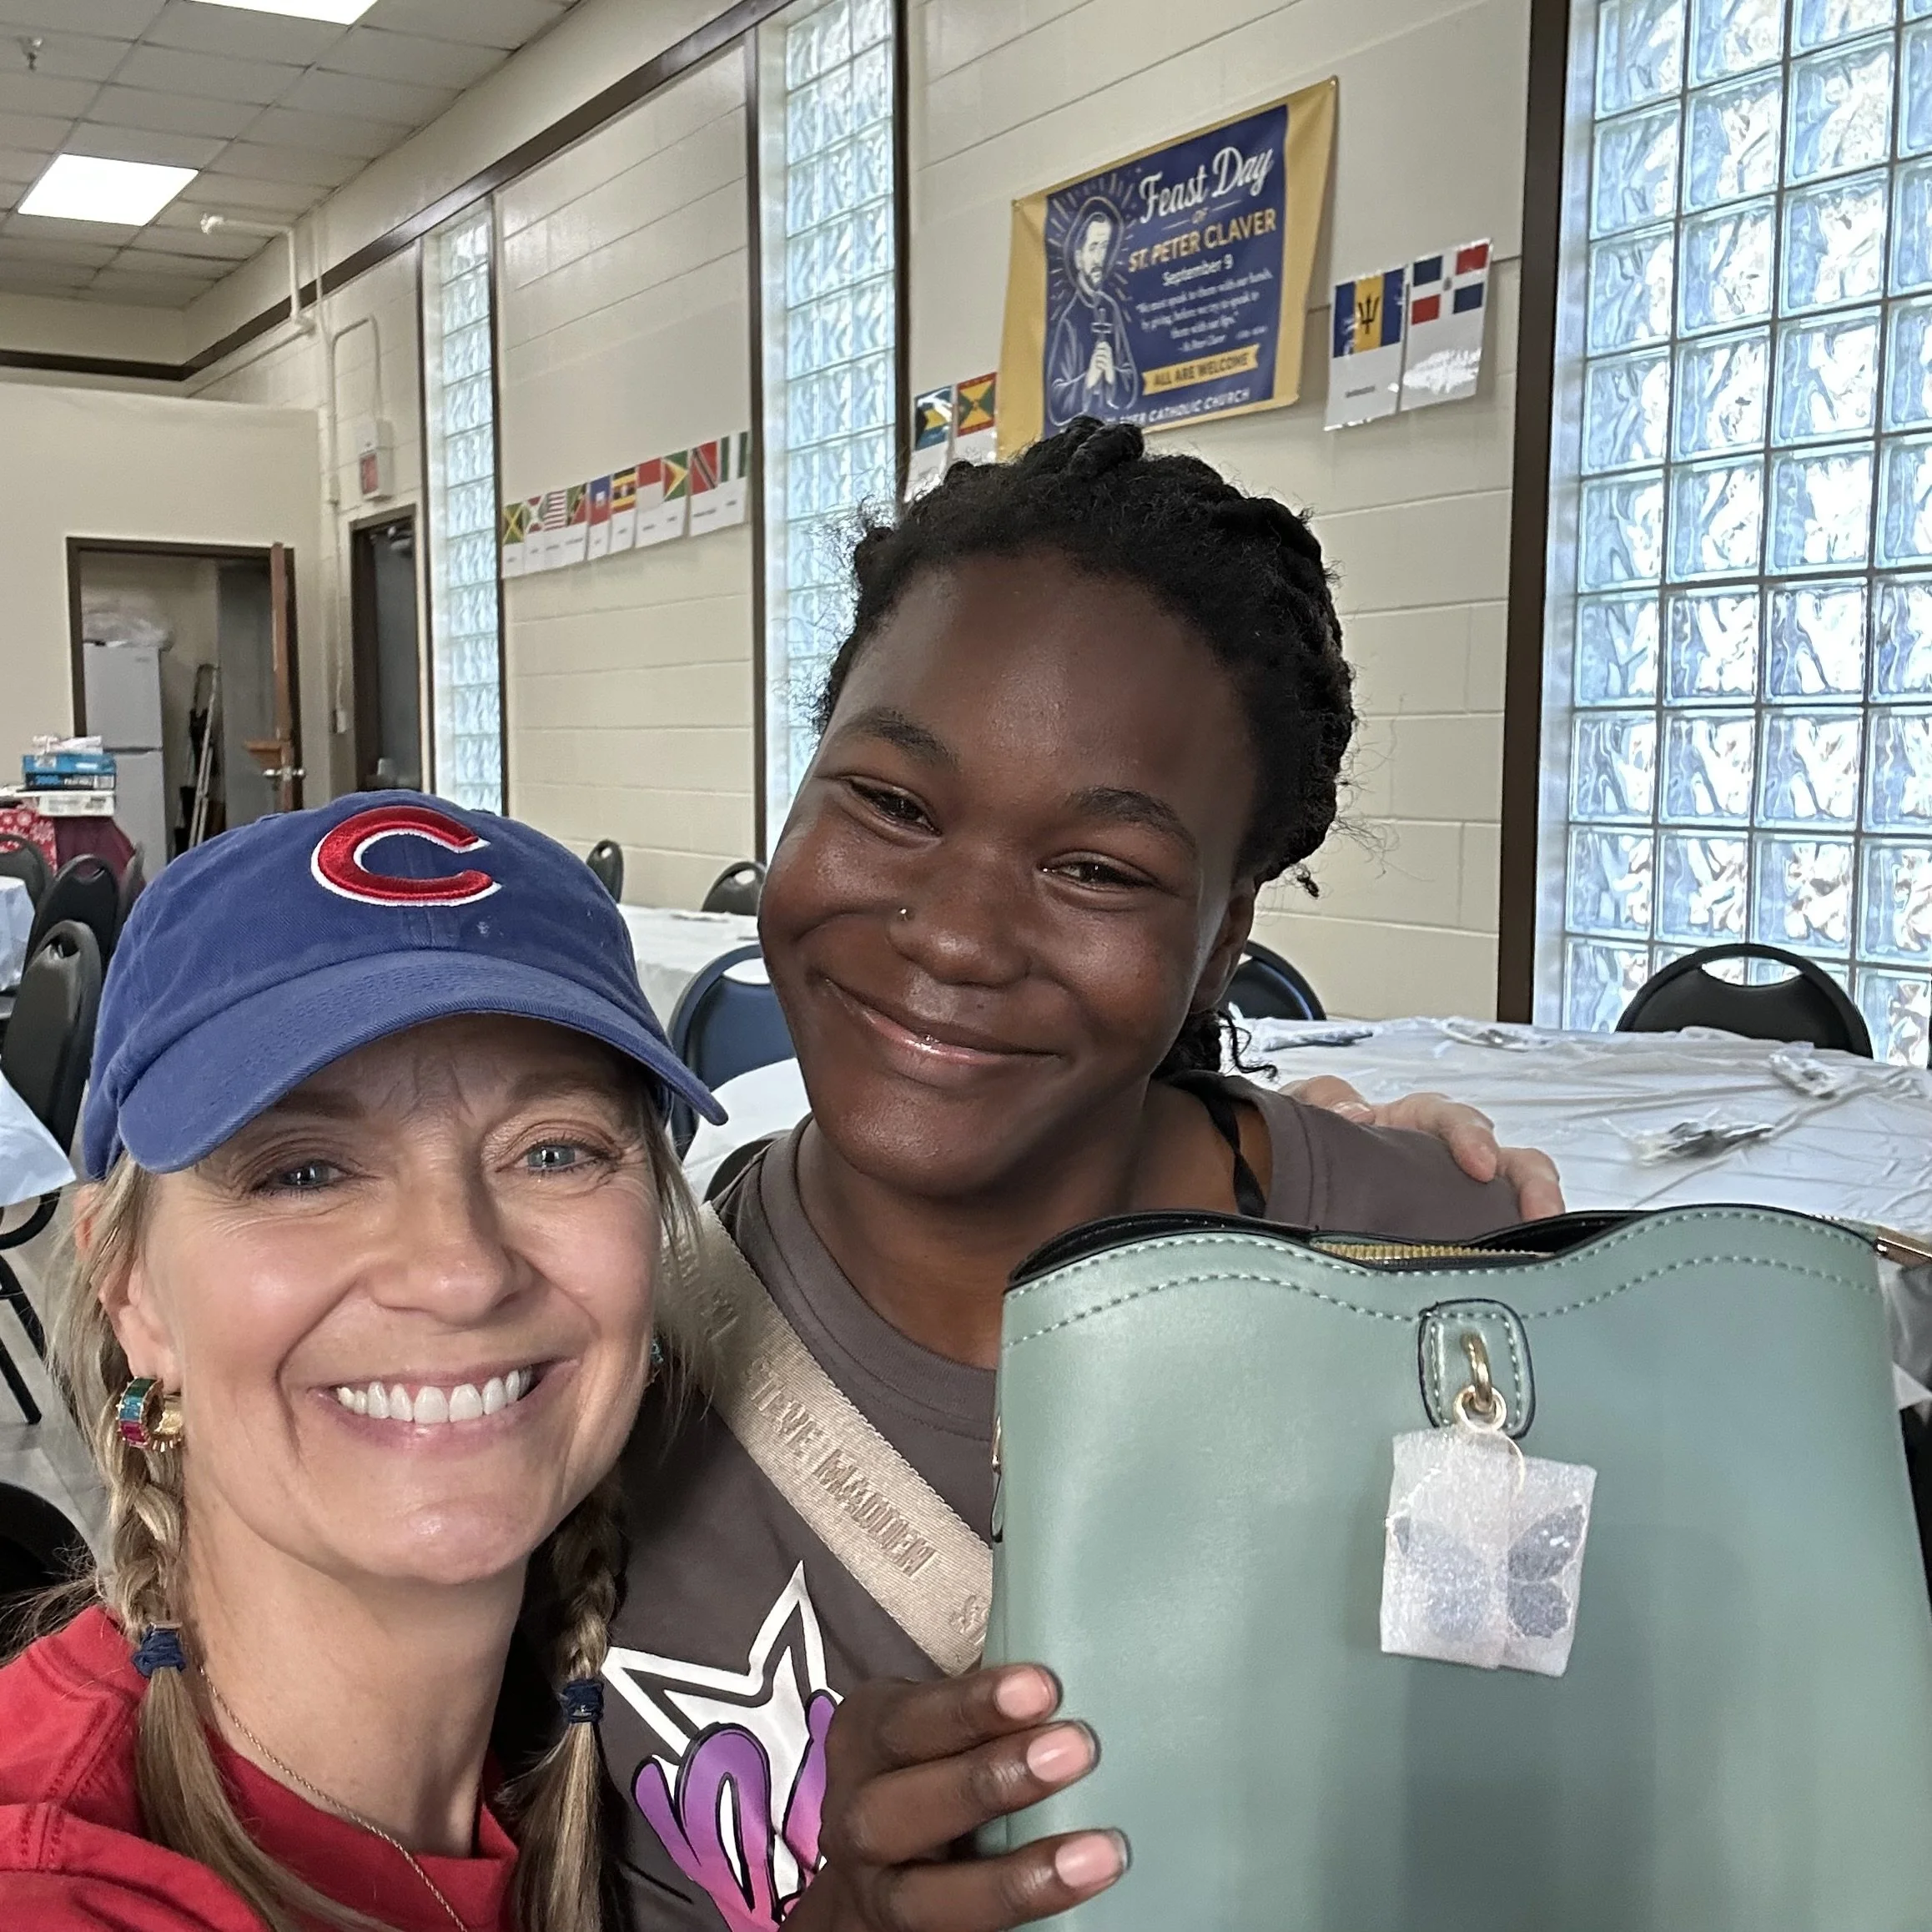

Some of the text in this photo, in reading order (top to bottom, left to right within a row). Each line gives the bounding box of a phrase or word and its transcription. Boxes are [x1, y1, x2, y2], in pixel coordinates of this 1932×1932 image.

[1139, 146, 1274, 224] Feast Day
[1151, 230, 1200, 265] PETER
[1205, 209, 1276, 249] CLAVER
[1162, 254, 1234, 287] September 9
[1175, 365, 1195, 382] ARE
[1197, 351, 1250, 377] WELCOME
[1149, 399, 1203, 423] CATHOLIC
[1204, 387, 1250, 410] CHURCH
[311, 804, 501, 908] C
[746, 1355, 938, 1578] STEVE MADDEN
